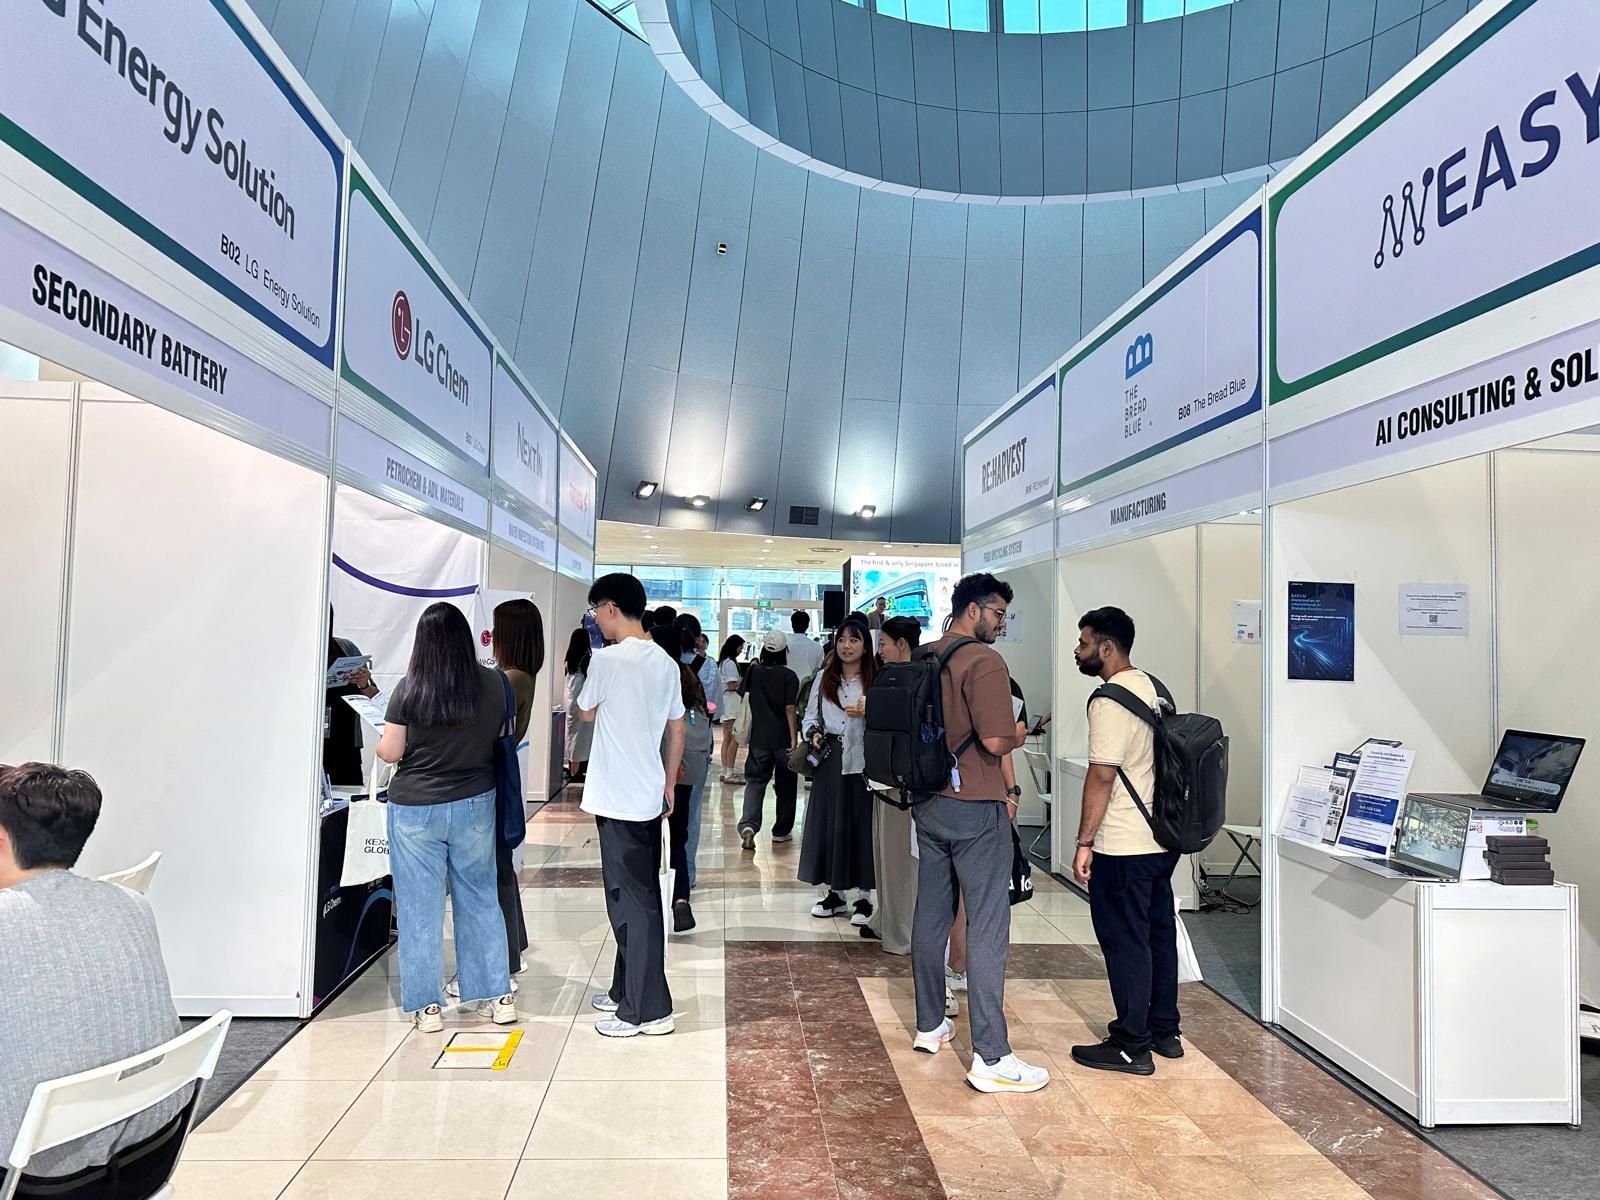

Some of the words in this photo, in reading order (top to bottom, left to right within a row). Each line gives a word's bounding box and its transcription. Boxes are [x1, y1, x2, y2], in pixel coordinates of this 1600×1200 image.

[77, 0, 201, 154] Energy
[205, 108, 295, 240] Solution
[221, 233, 241, 266] B02
[245, 253, 259, 280] LG
[263, 269, 290, 309] Energy
[291, 292, 320, 328] Solution
[32, 264, 156, 359] SECONDARY
[161, 332, 228, 395] BATTERY
[415, 318, 434, 374] LG
[437, 343, 468, 407] Chem
[1125, 384, 1138, 404] THE
[1125, 397, 1147, 421] BREAD
[1178, 404, 1191, 420] B08
[1194, 398, 1206, 412] The
[1207, 384, 1228, 406] Bread
[1229, 379, 1246, 395] Blue
[1375, 417, 1392, 447] AI
[1397, 375, 1515, 440] CONSULTING
[1524, 367, 1543, 401] &
[1125, 418, 1142, 438] BLUE
[386, 456, 421, 493] PETROCHEM
[422, 477, 427, 494] &
[440, 485, 464, 512] MATERIALS
[982, 437, 1027, 494] RE:HARVEST
[1110, 493, 1166, 525] MANUFACTURING
